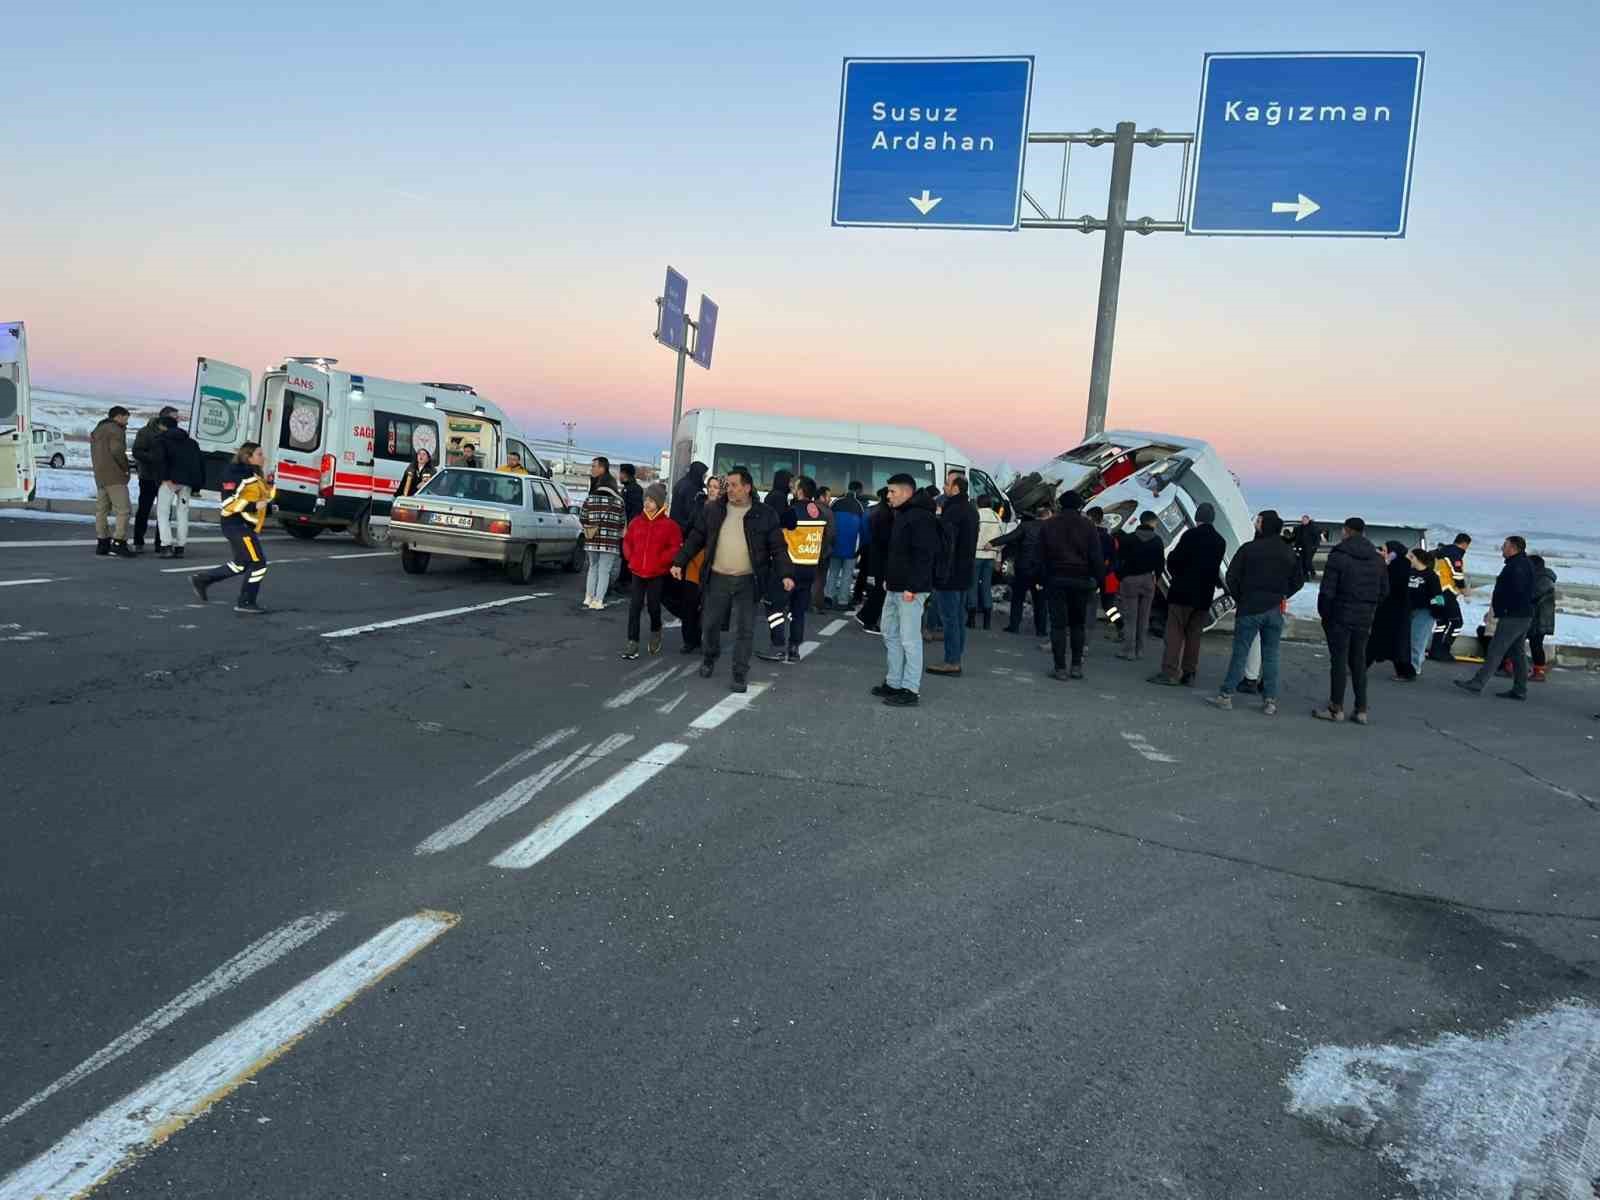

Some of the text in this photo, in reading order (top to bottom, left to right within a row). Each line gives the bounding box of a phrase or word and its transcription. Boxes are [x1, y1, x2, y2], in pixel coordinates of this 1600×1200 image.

[872, 101, 958, 121] Susuz
[1224, 101, 1391, 126] Kağızman
[871, 131, 994, 151] Ardahan
